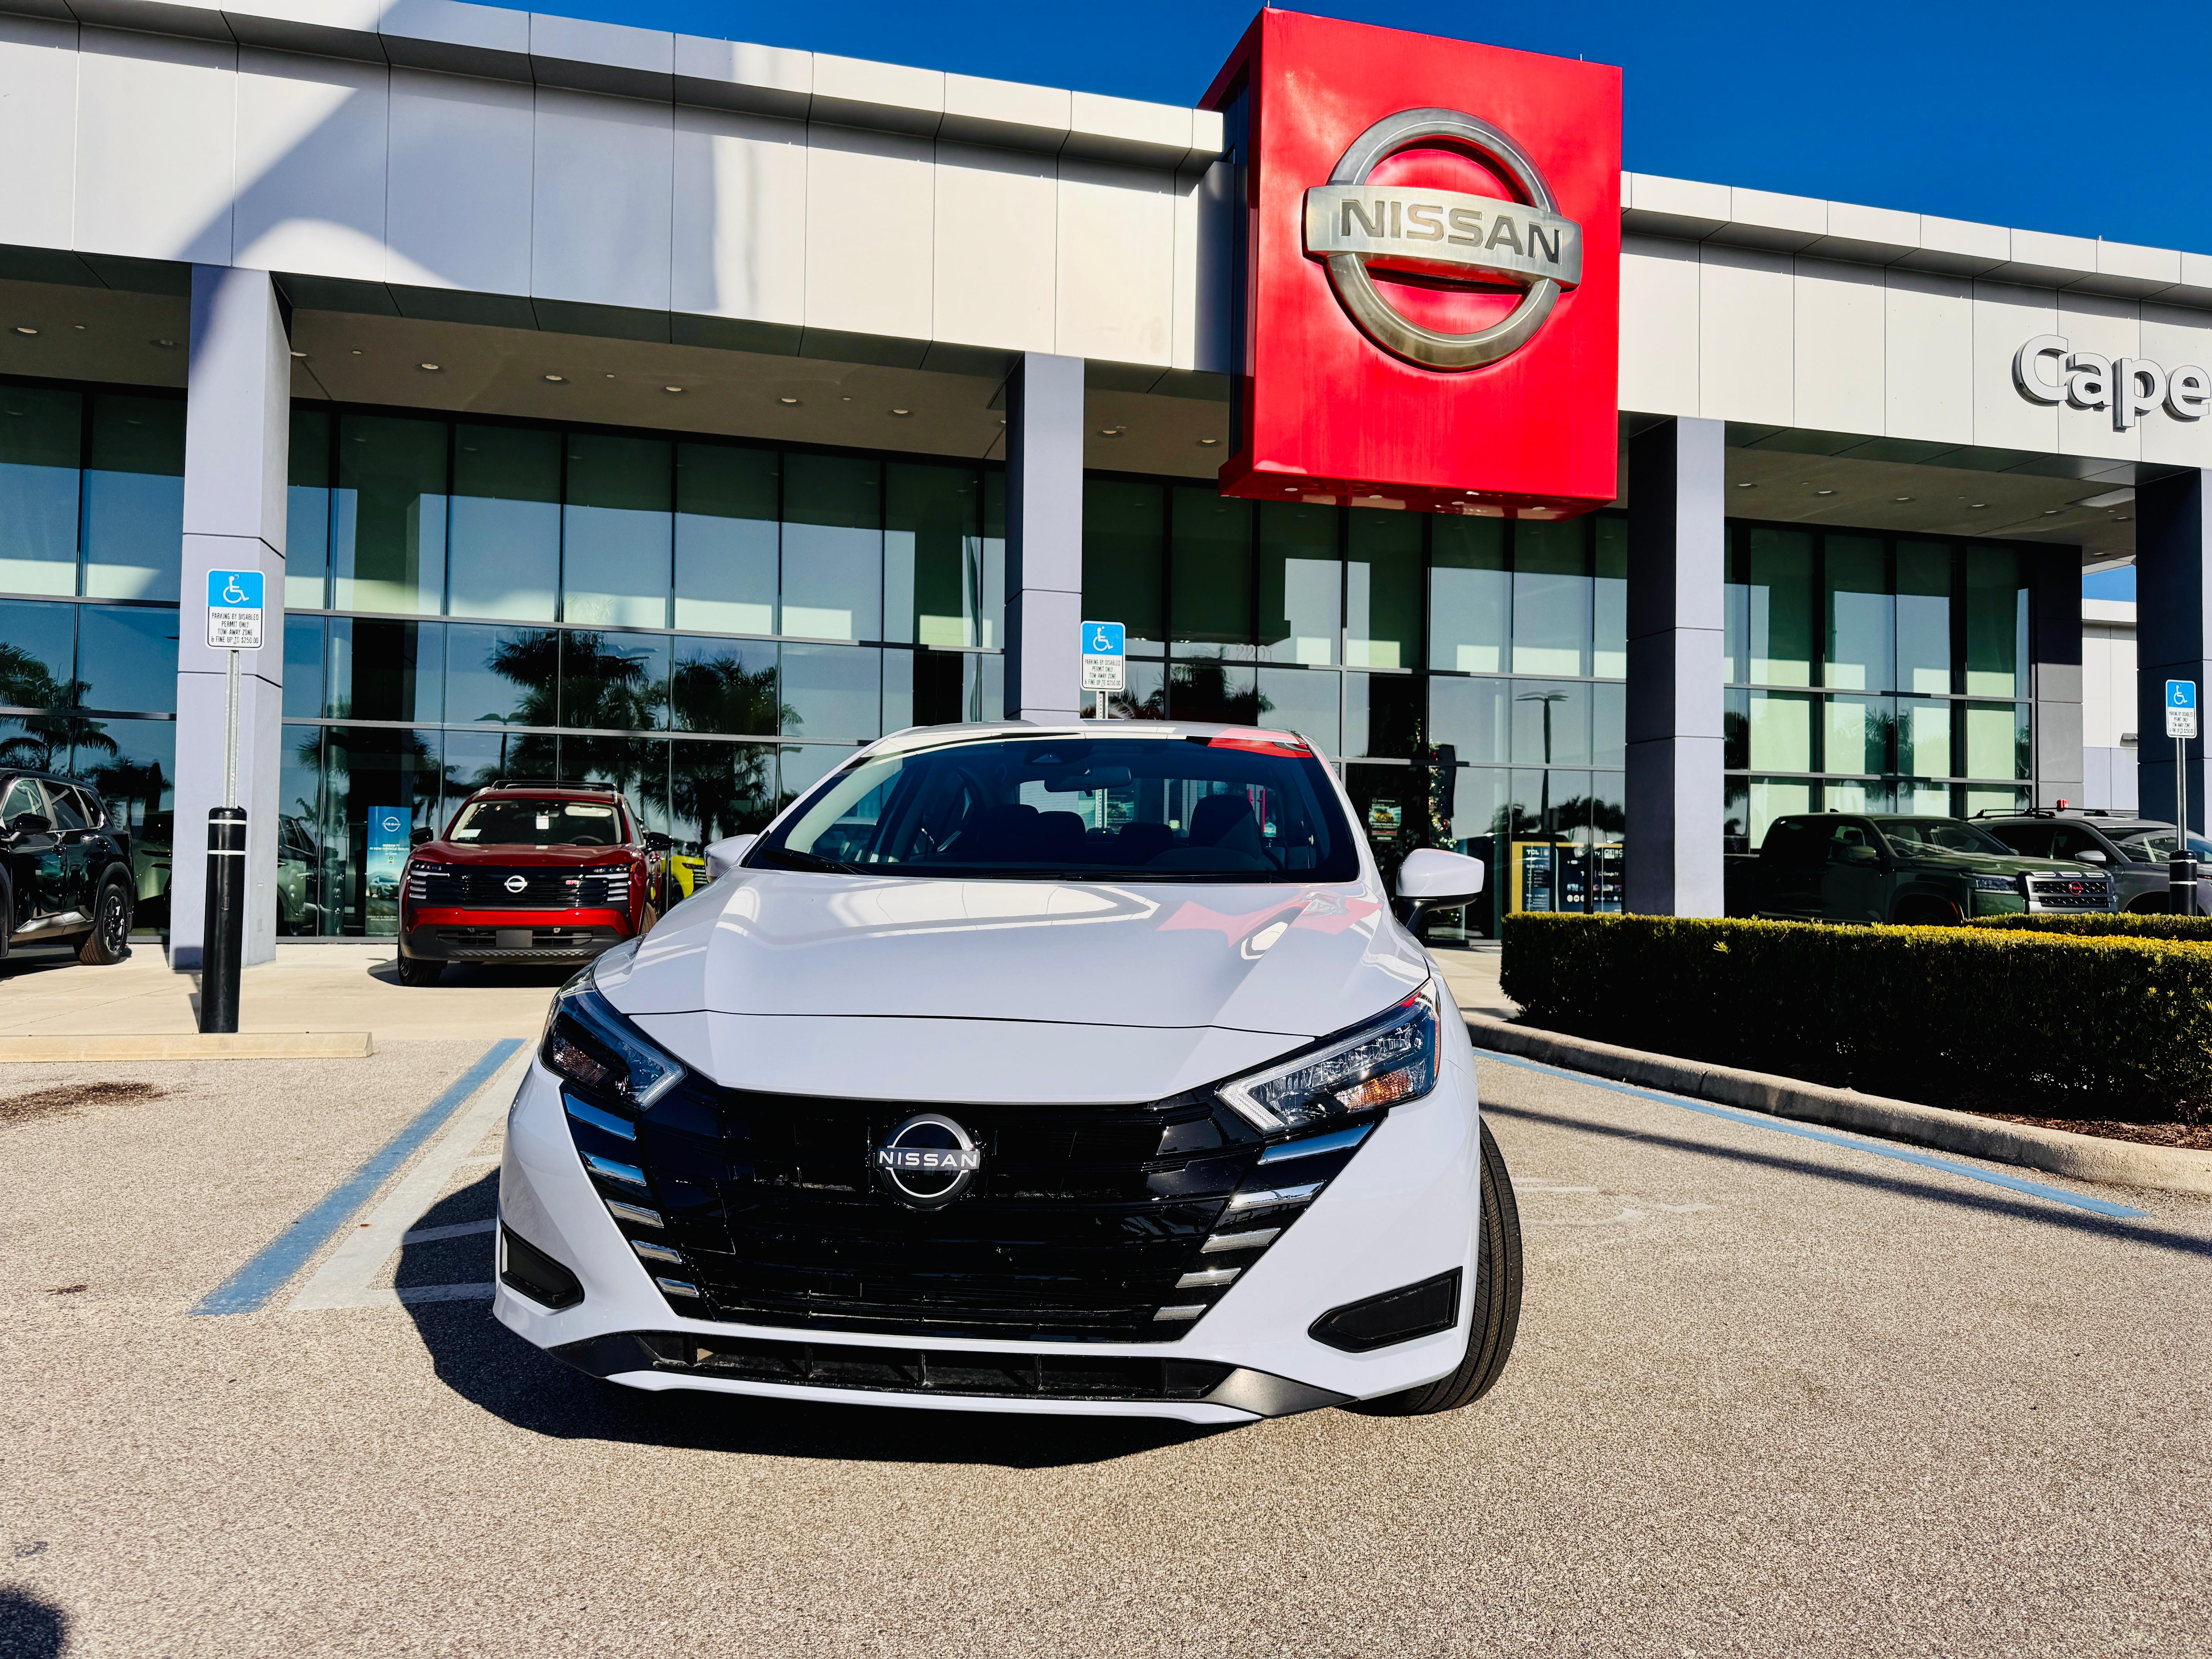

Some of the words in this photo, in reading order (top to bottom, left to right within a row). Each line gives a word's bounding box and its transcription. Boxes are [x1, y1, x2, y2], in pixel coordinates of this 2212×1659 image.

[1340, 199, 1562, 265] NISSAN
[2012, 334, 2212, 431] Cape
[1237, 644, 1273, 662] 2201
[879, 1151, 977, 1167] NISSAN
